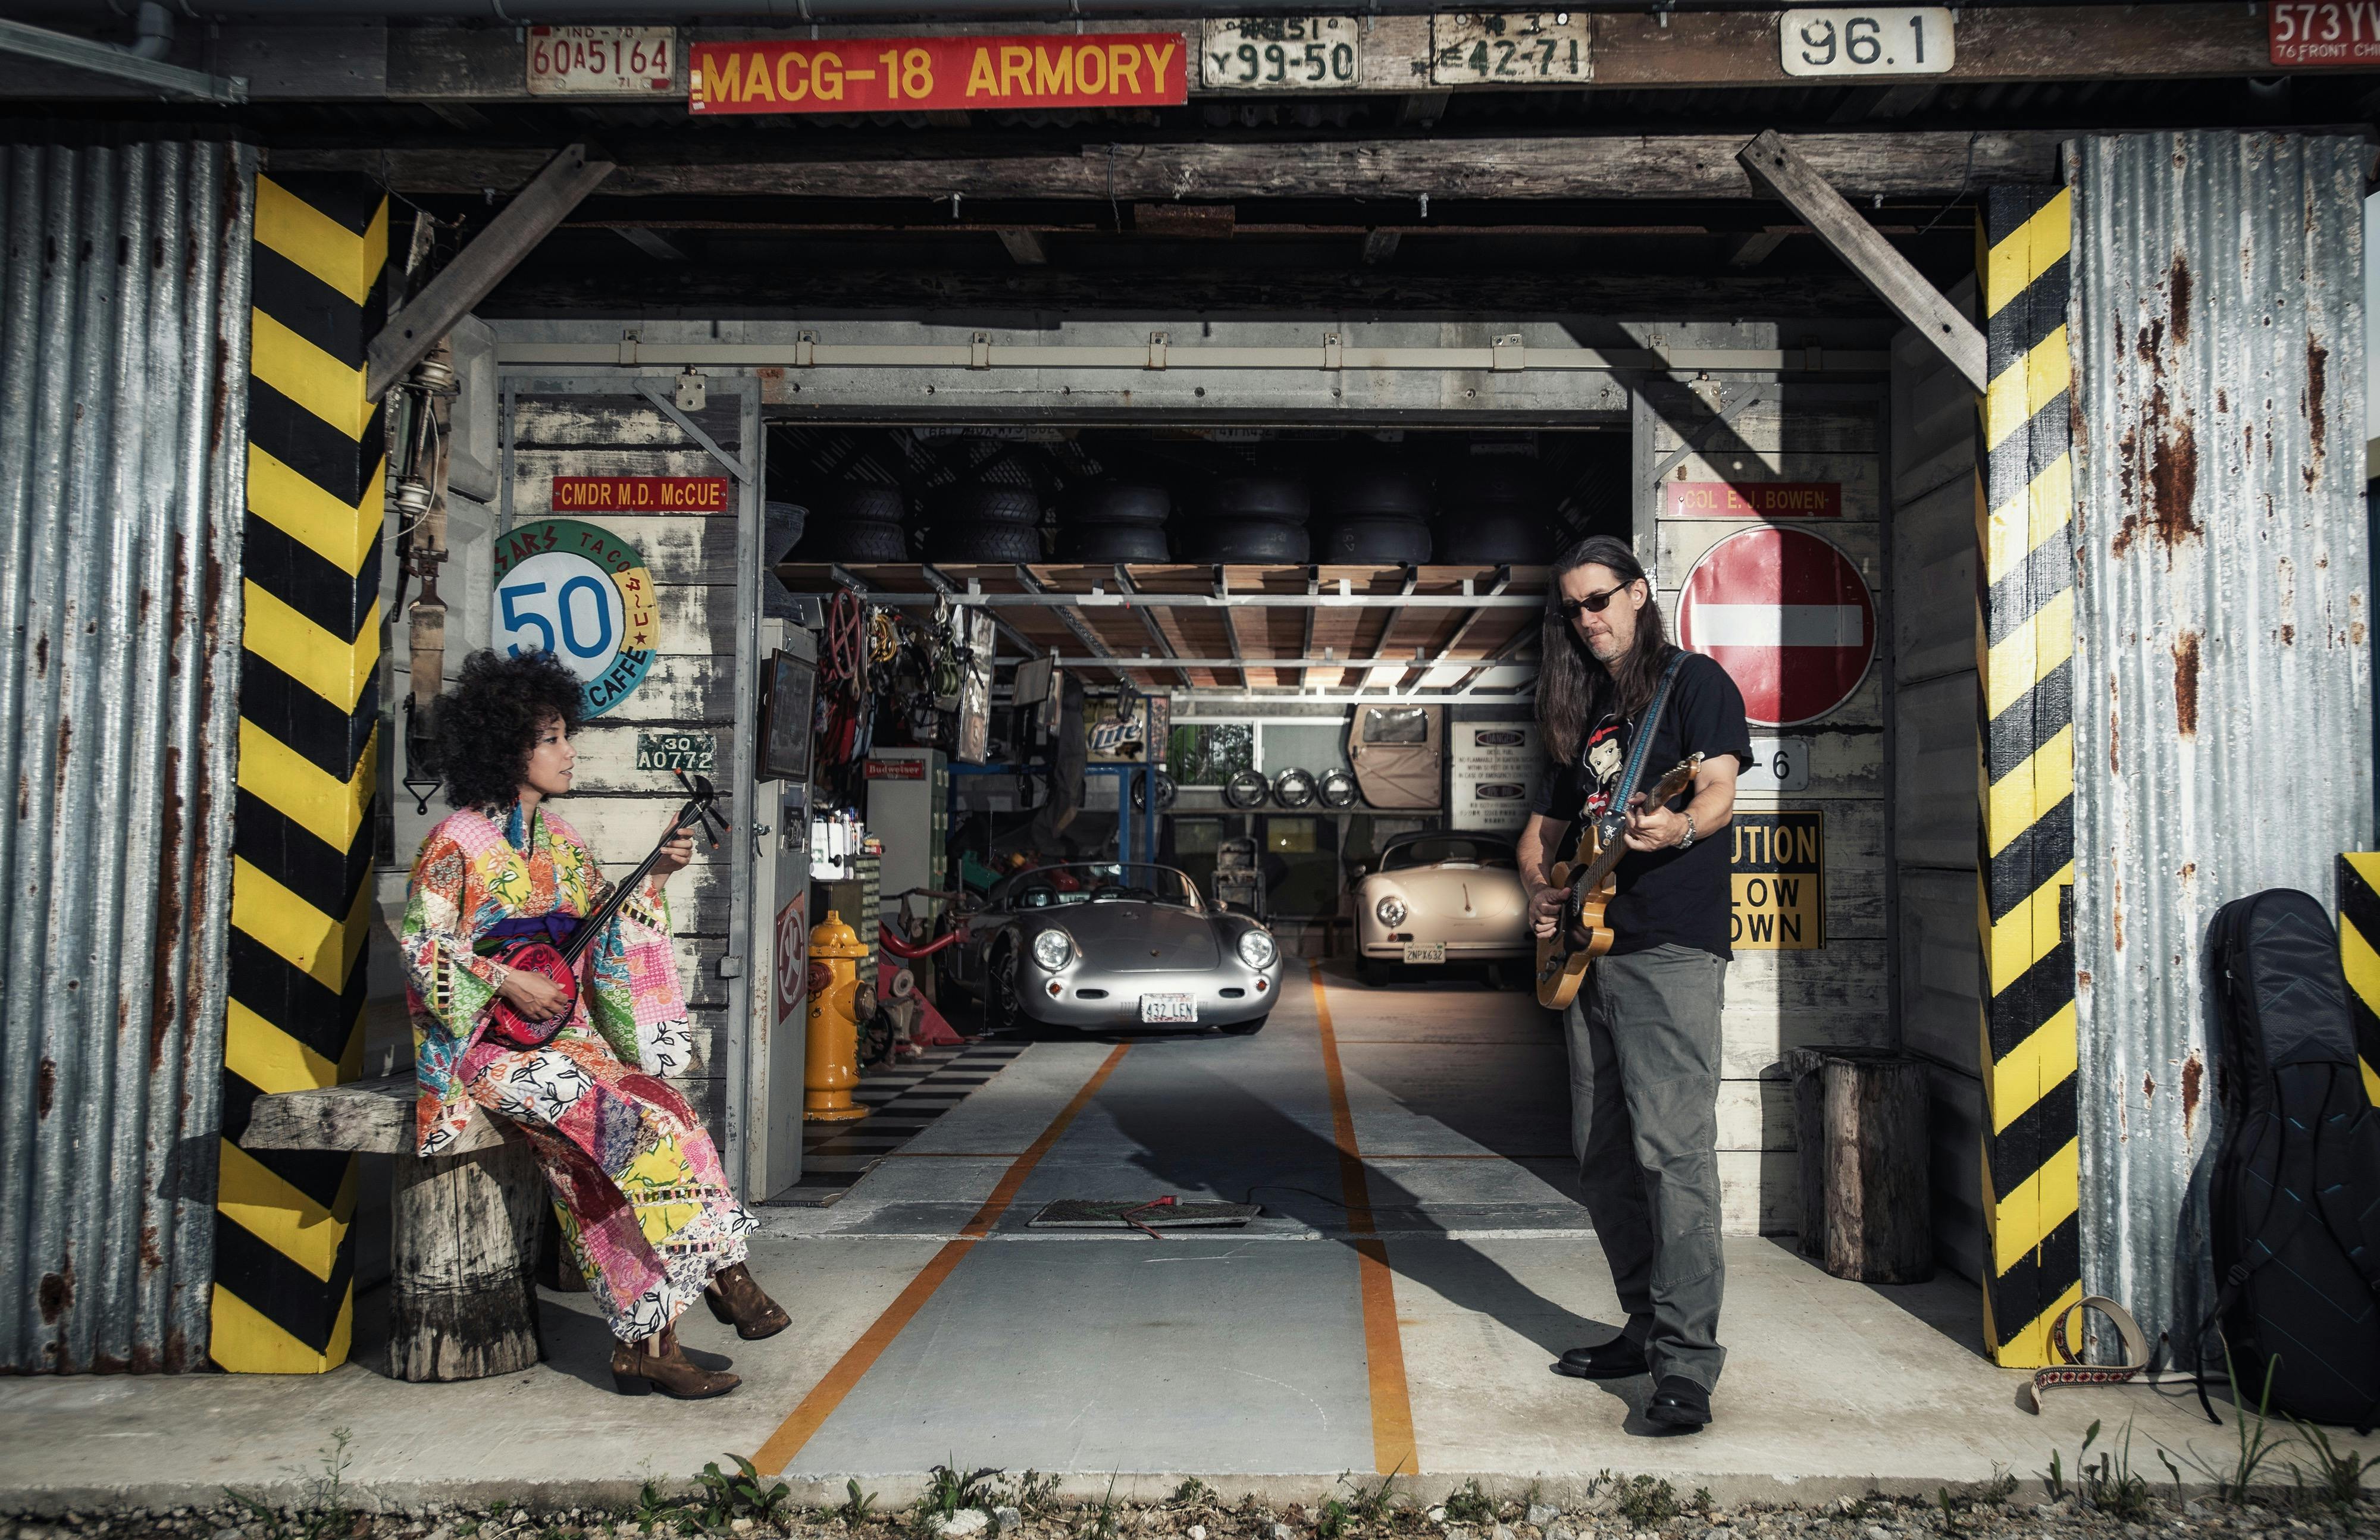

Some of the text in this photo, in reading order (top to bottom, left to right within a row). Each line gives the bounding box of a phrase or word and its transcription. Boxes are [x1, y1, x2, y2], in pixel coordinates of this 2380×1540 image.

[1800, 15, 1924, 65] 96.1
[2299, 43, 2348, 57] FRONT
[534, 40, 668, 75] 60A5164
[1237, 43, 1353, 81] 99-50
[702, 43, 1176, 103] MACG-18 ARMORY
[561, 482, 720, 506] CMDR M.D. McCUE
[1685, 490, 1718, 509] COL
[1765, 490, 1825, 509] BOWEN
[500, 575, 612, 661] 50
[665, 738, 690, 751] 30
[869, 764, 919, 774] Budweiser
